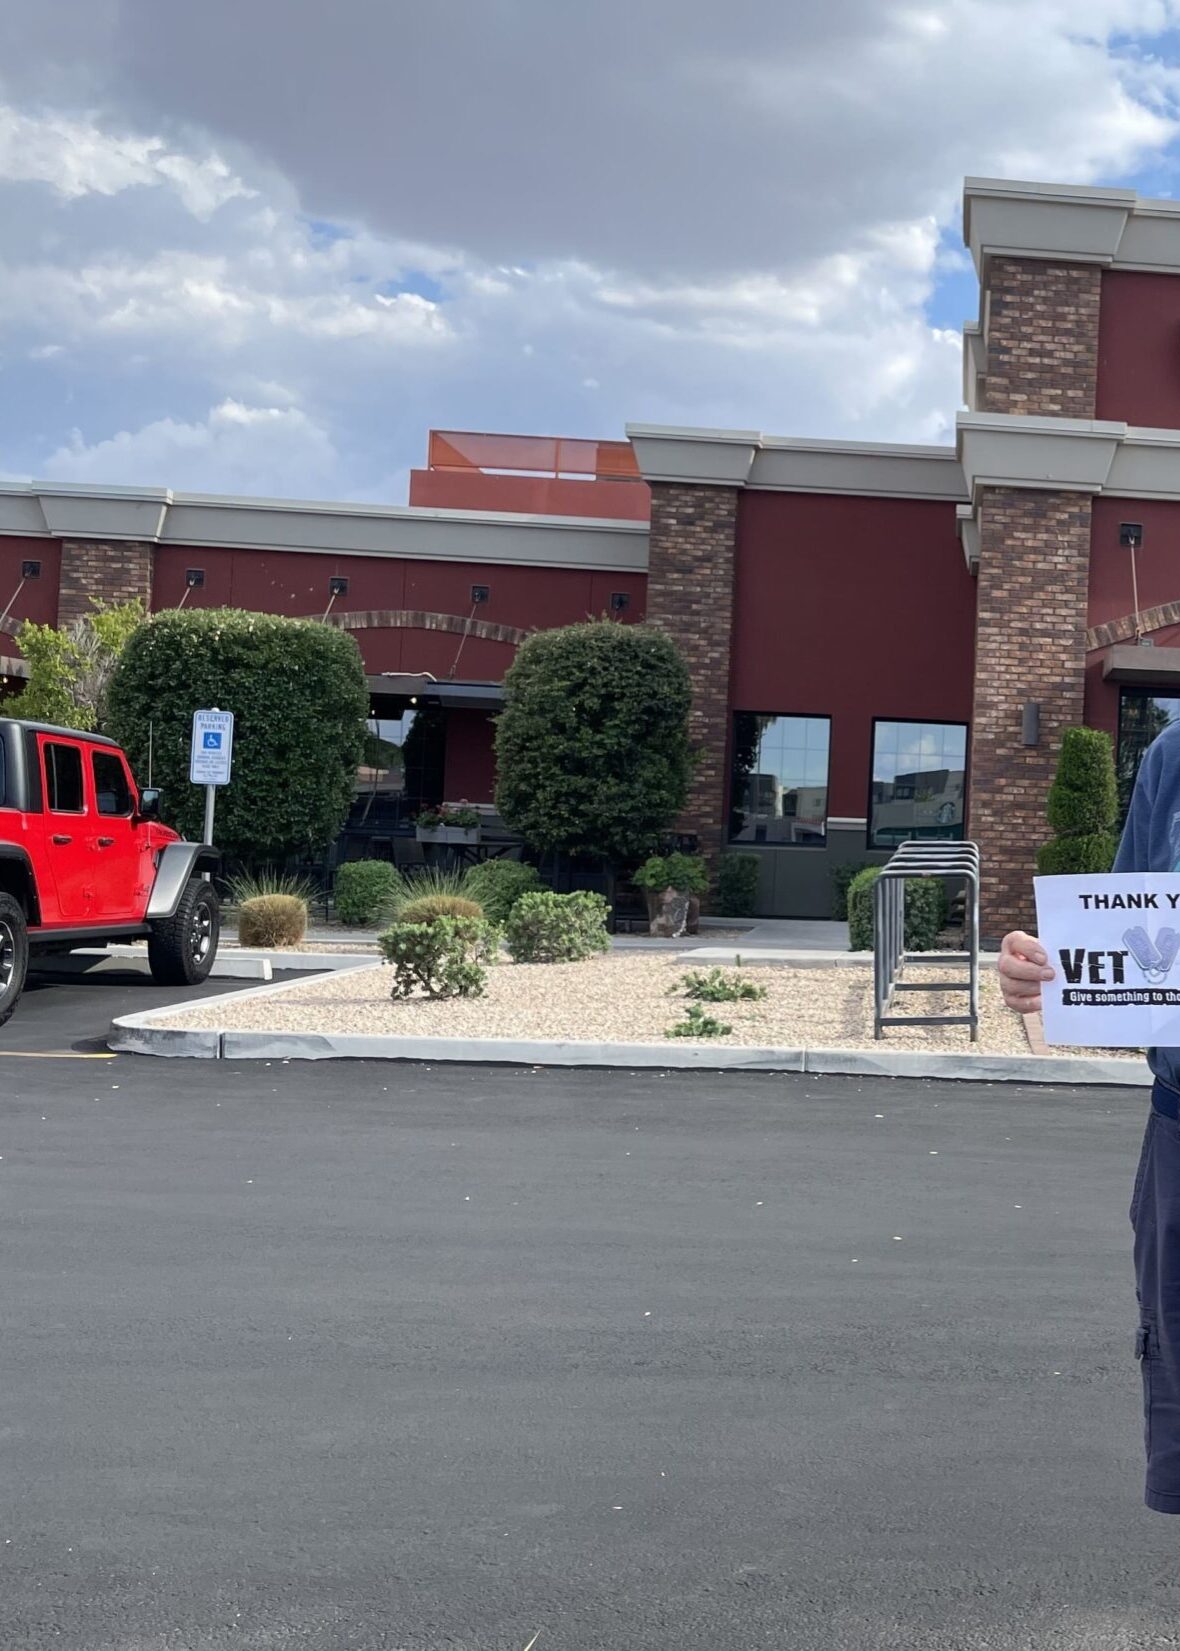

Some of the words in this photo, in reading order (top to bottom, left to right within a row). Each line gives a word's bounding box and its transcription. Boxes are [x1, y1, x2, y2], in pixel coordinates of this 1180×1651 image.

[1079, 893, 1160, 909] THANK
[1058, 948, 1128, 984] VET
[1069, 991, 1092, 1001] Give
[1095, 991, 1149, 1002] something
[1152, 992, 1163, 1001] to
